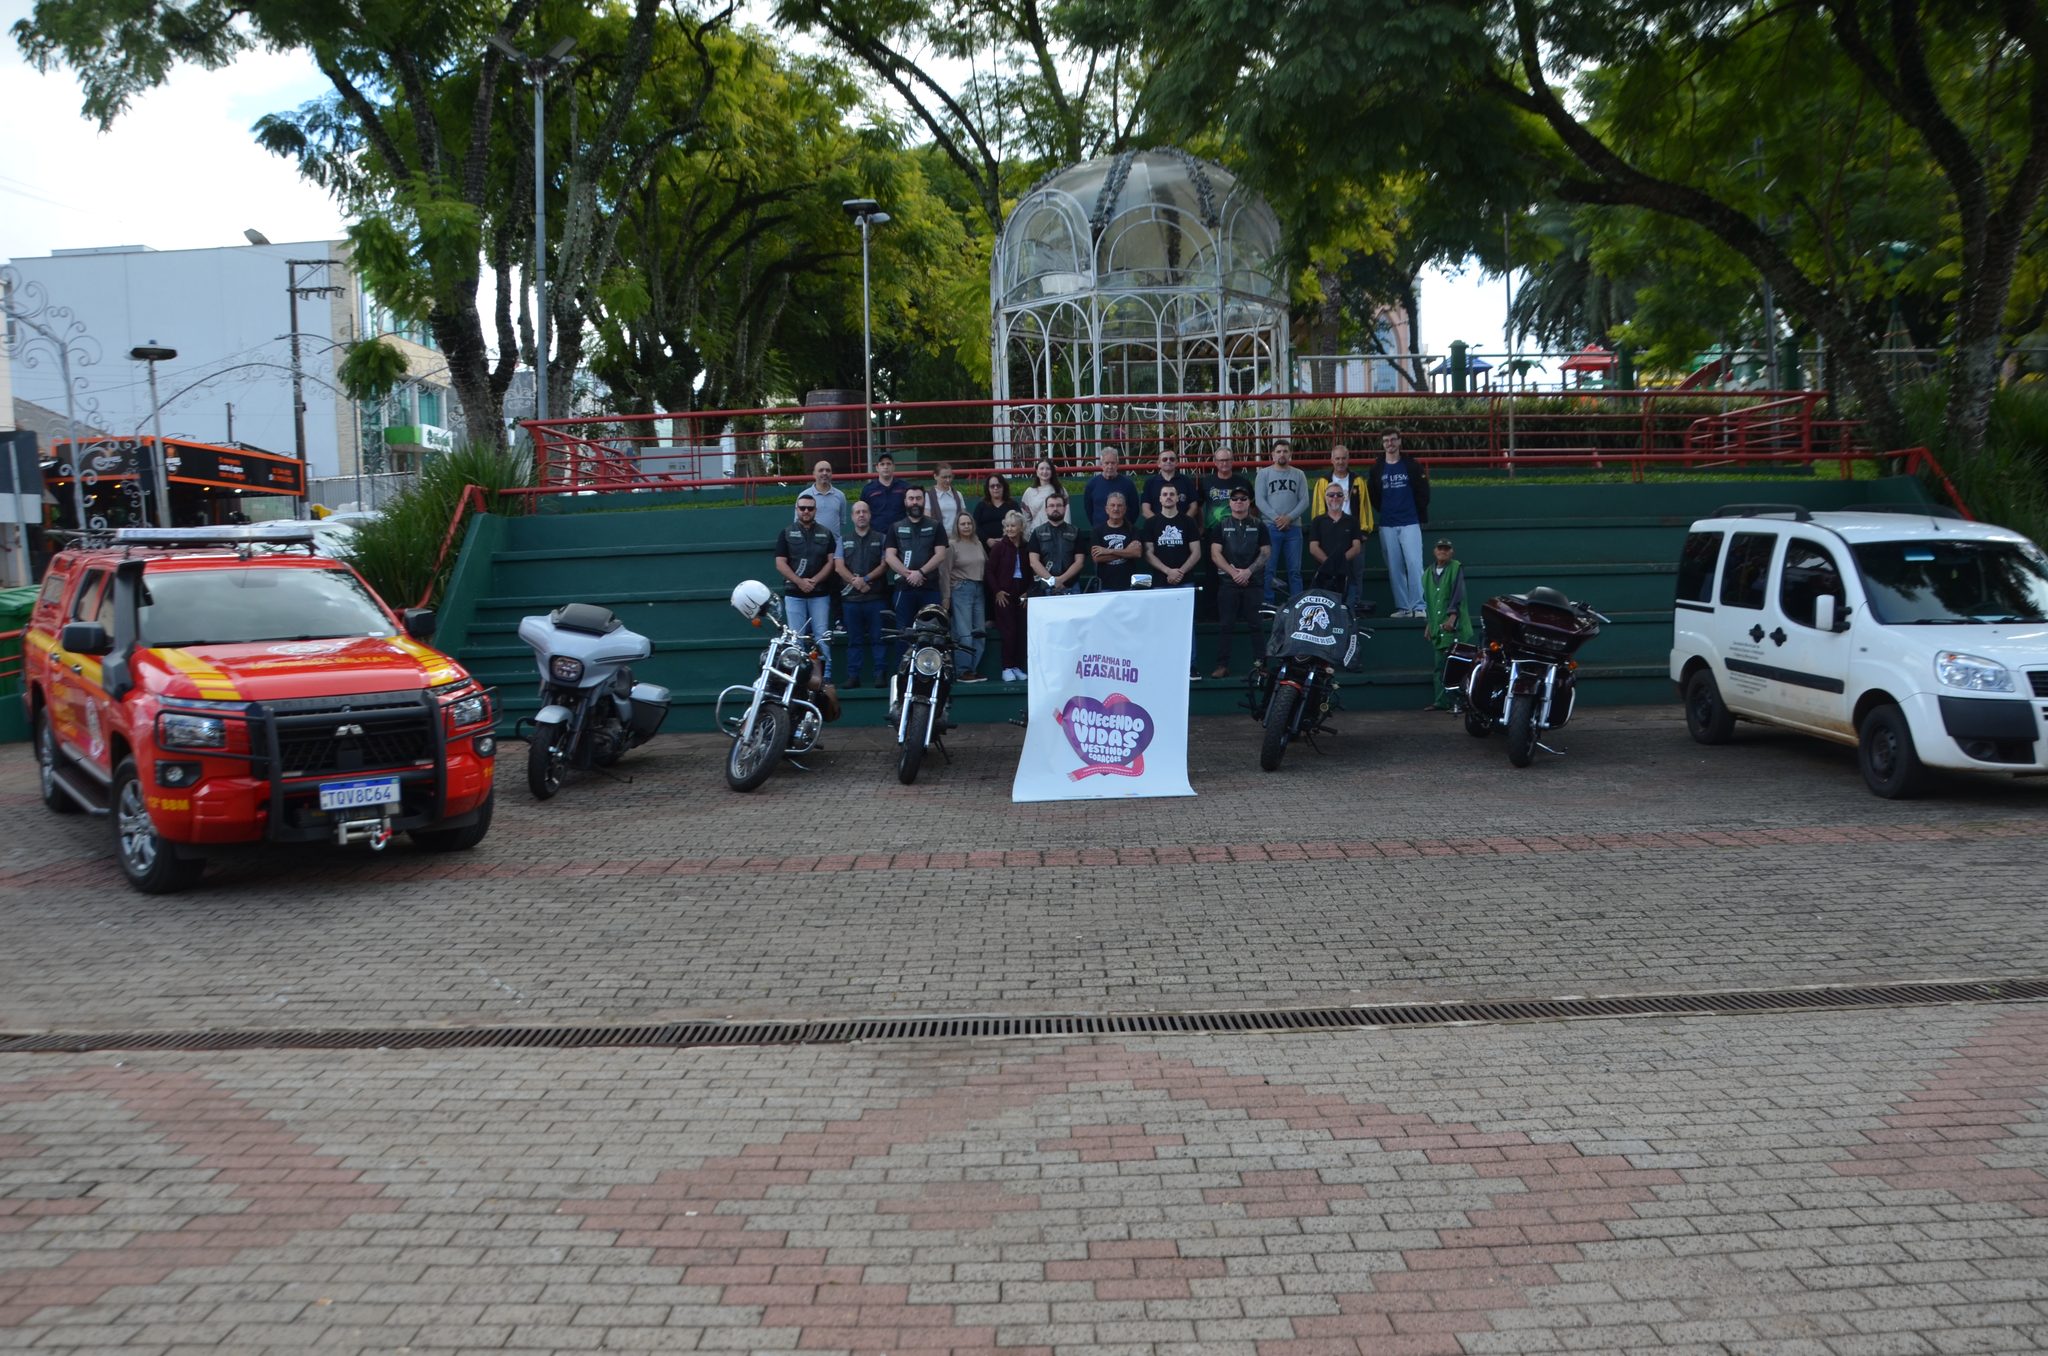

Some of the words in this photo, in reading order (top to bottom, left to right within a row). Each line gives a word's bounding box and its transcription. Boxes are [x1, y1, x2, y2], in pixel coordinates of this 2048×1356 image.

[1269, 480, 1297, 493] TXC
[1083, 654, 1120, 666] CAMPANHA
[1122, 658, 1131, 667] DO
[1076, 660, 1139, 683] AGASALHO
[1072, 707, 1145, 732] AQUECENDO
[1074, 723, 1139, 748] VIDAS
[1081, 742, 1131, 756] VESTINDO
